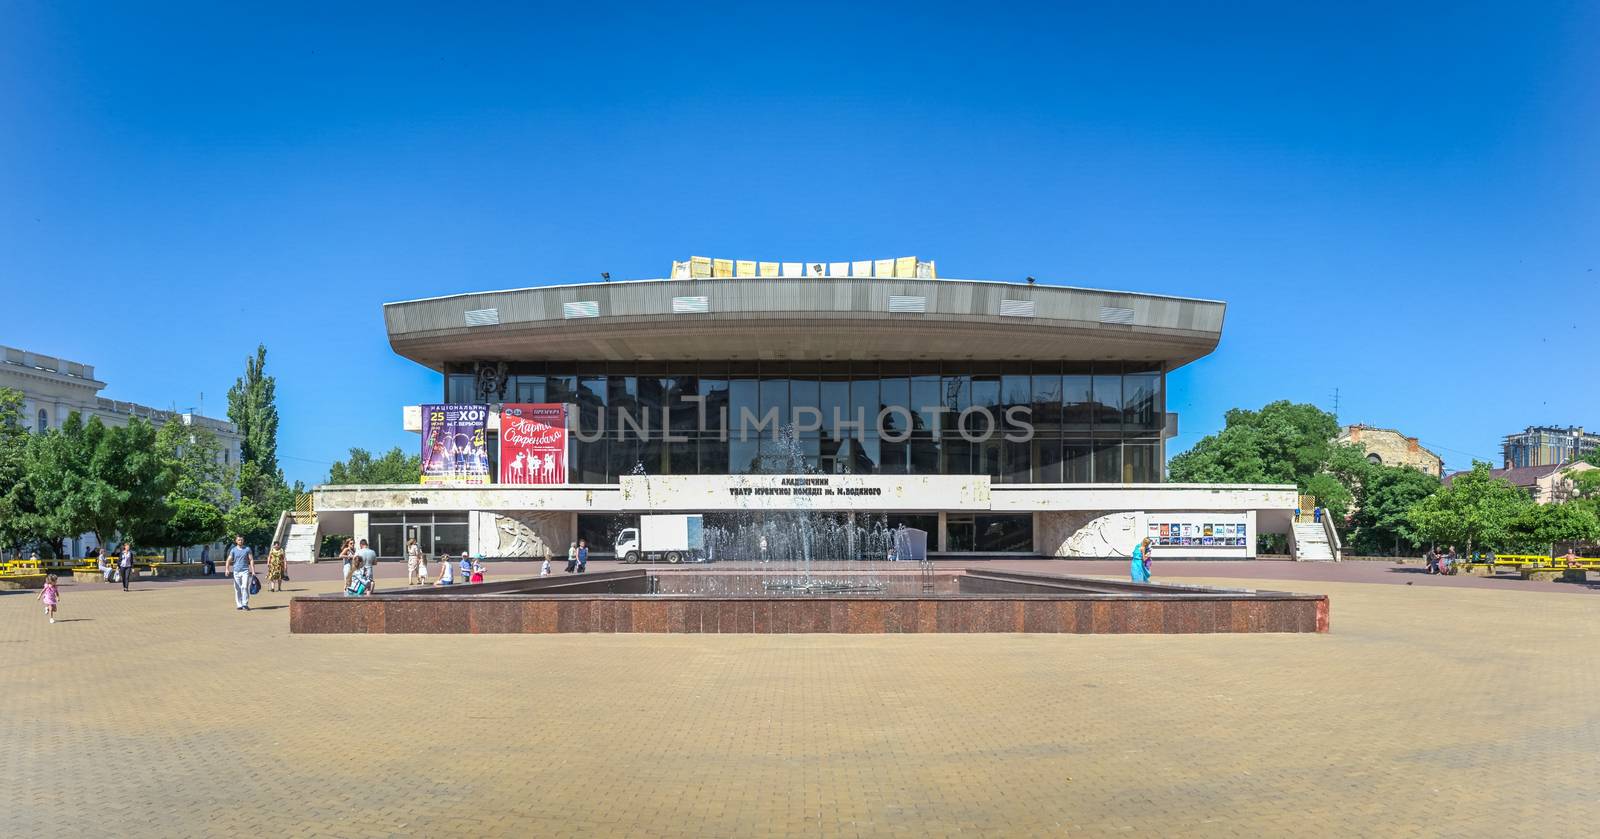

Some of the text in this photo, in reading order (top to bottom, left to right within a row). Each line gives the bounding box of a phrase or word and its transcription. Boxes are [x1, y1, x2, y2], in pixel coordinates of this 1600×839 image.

[430, 412, 445, 421] 25
[458, 411, 486, 421] ХОР
[729, 487, 752, 496] ТЕАТР
